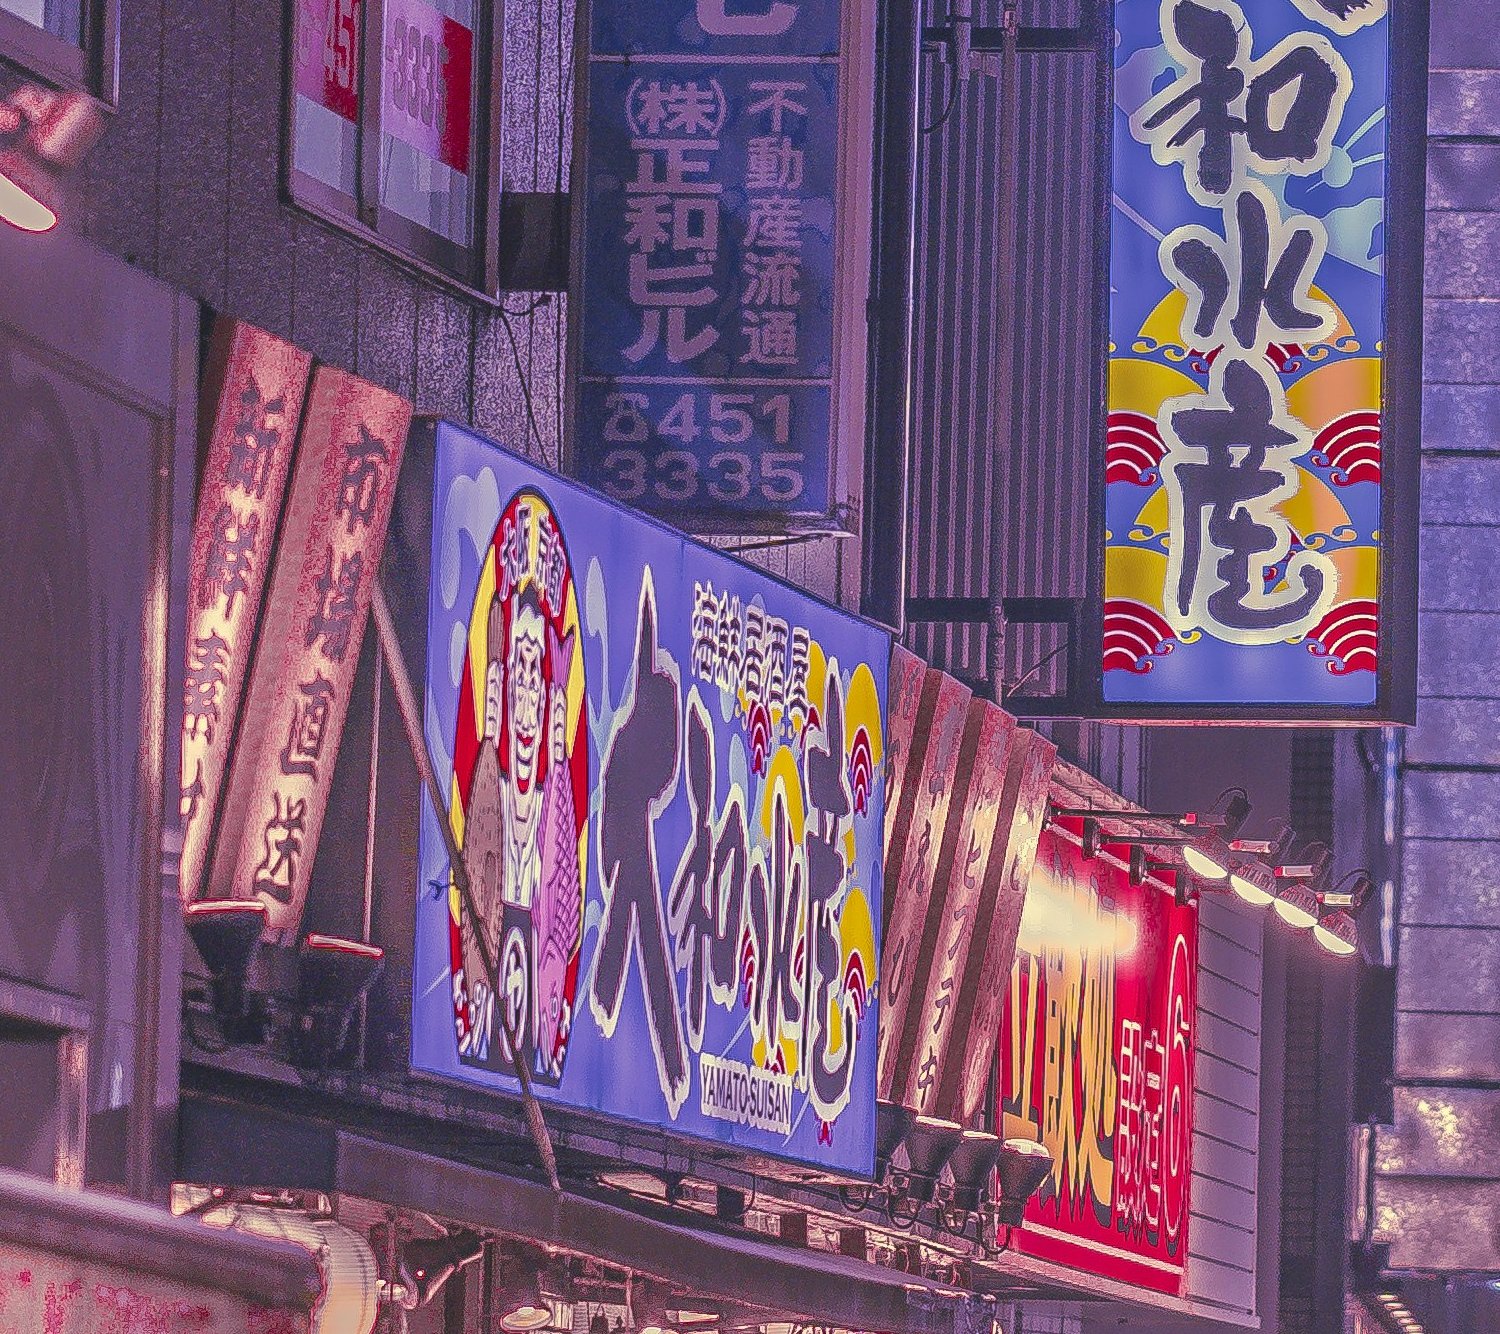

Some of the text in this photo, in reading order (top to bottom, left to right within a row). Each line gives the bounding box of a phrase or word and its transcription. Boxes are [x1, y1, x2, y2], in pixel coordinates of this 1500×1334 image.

[739, 79, 808, 366] 不動産流通
[602, 449, 805, 505] 3335
[691, 580, 810, 717] 海鮮居酒屋
